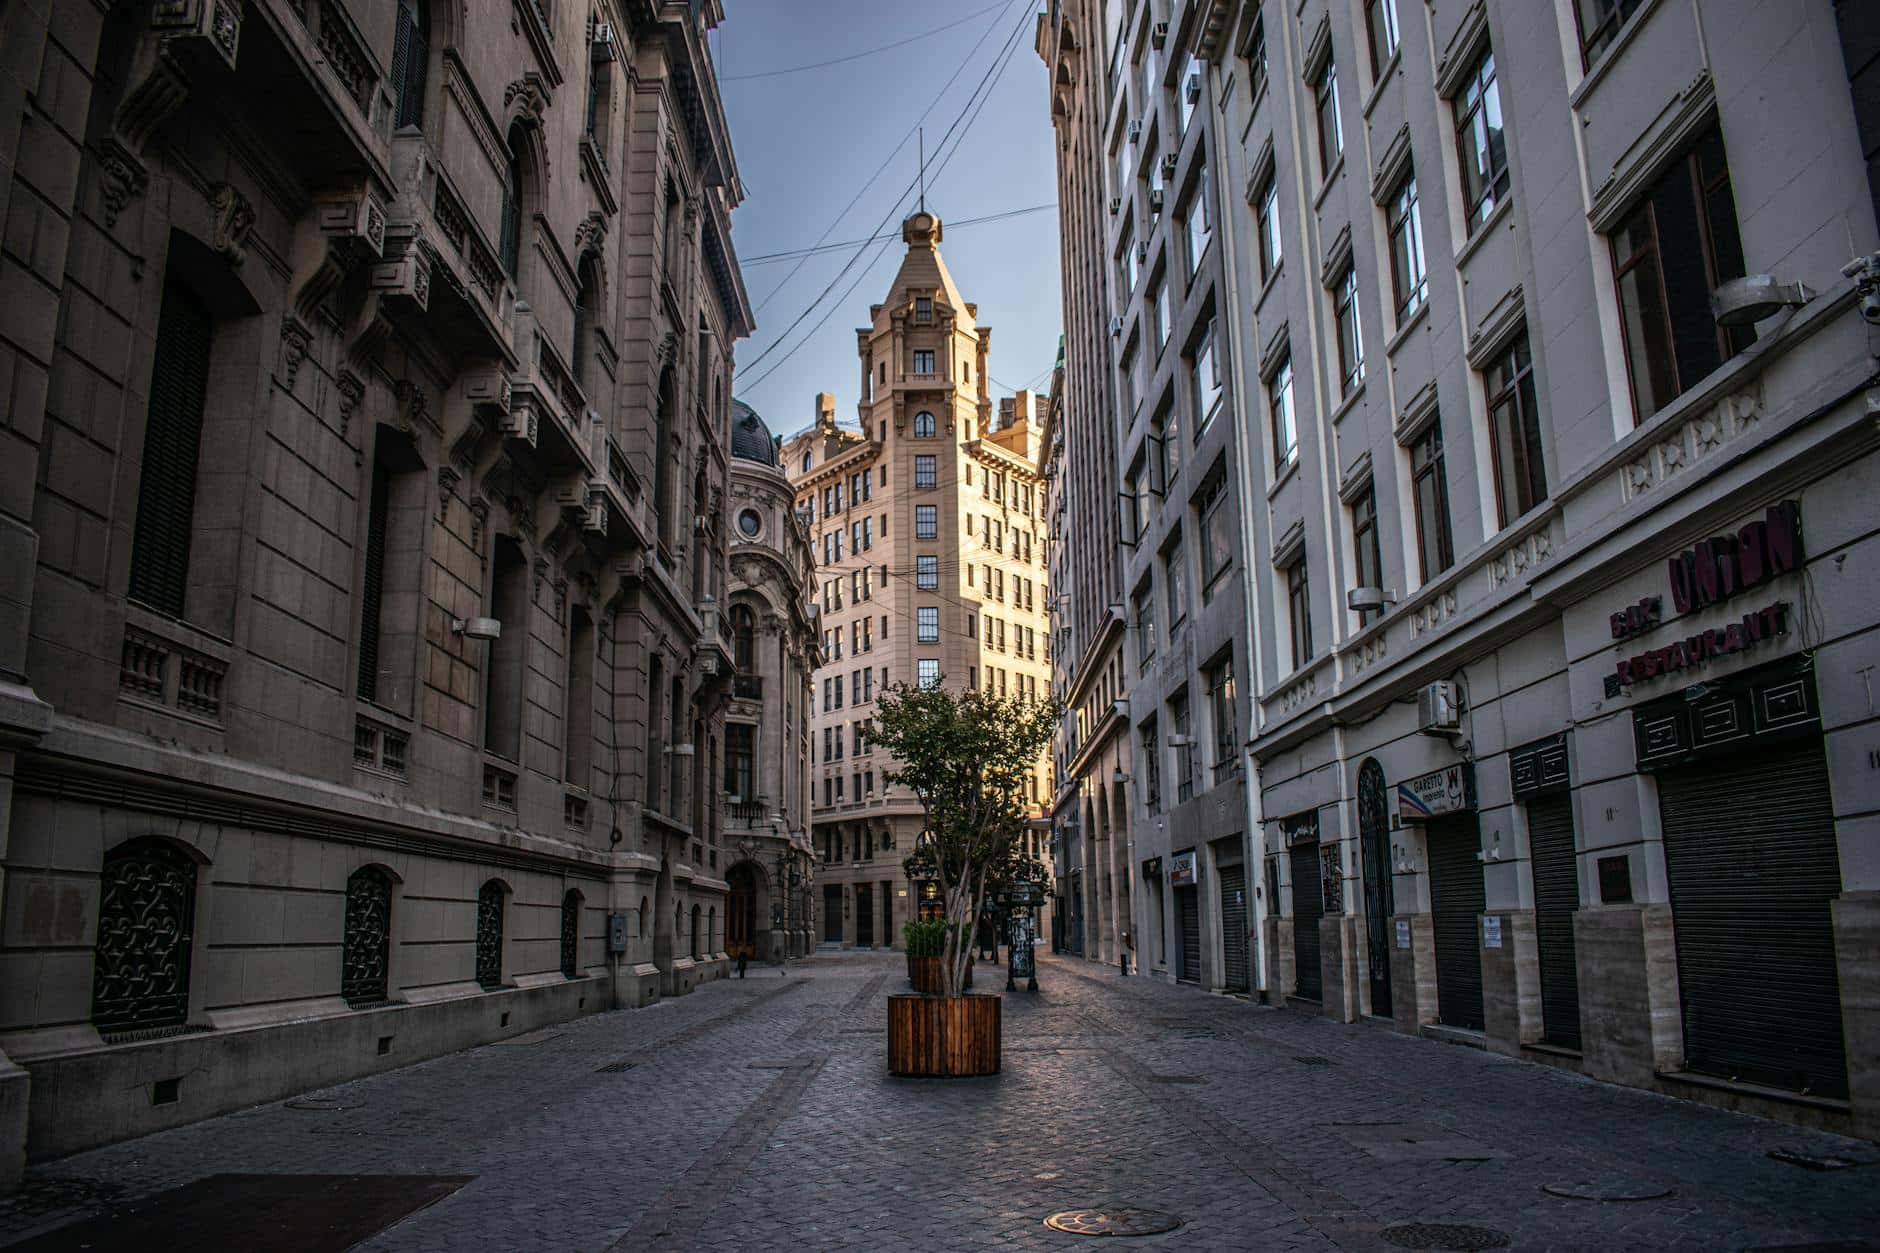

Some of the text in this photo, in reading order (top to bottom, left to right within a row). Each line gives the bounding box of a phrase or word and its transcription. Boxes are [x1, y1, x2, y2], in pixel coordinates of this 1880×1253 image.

[1610, 595, 1661, 639] BAR
[1617, 602, 1787, 685] RESTAURANT
[1413, 774, 1443, 794] GARETTO
